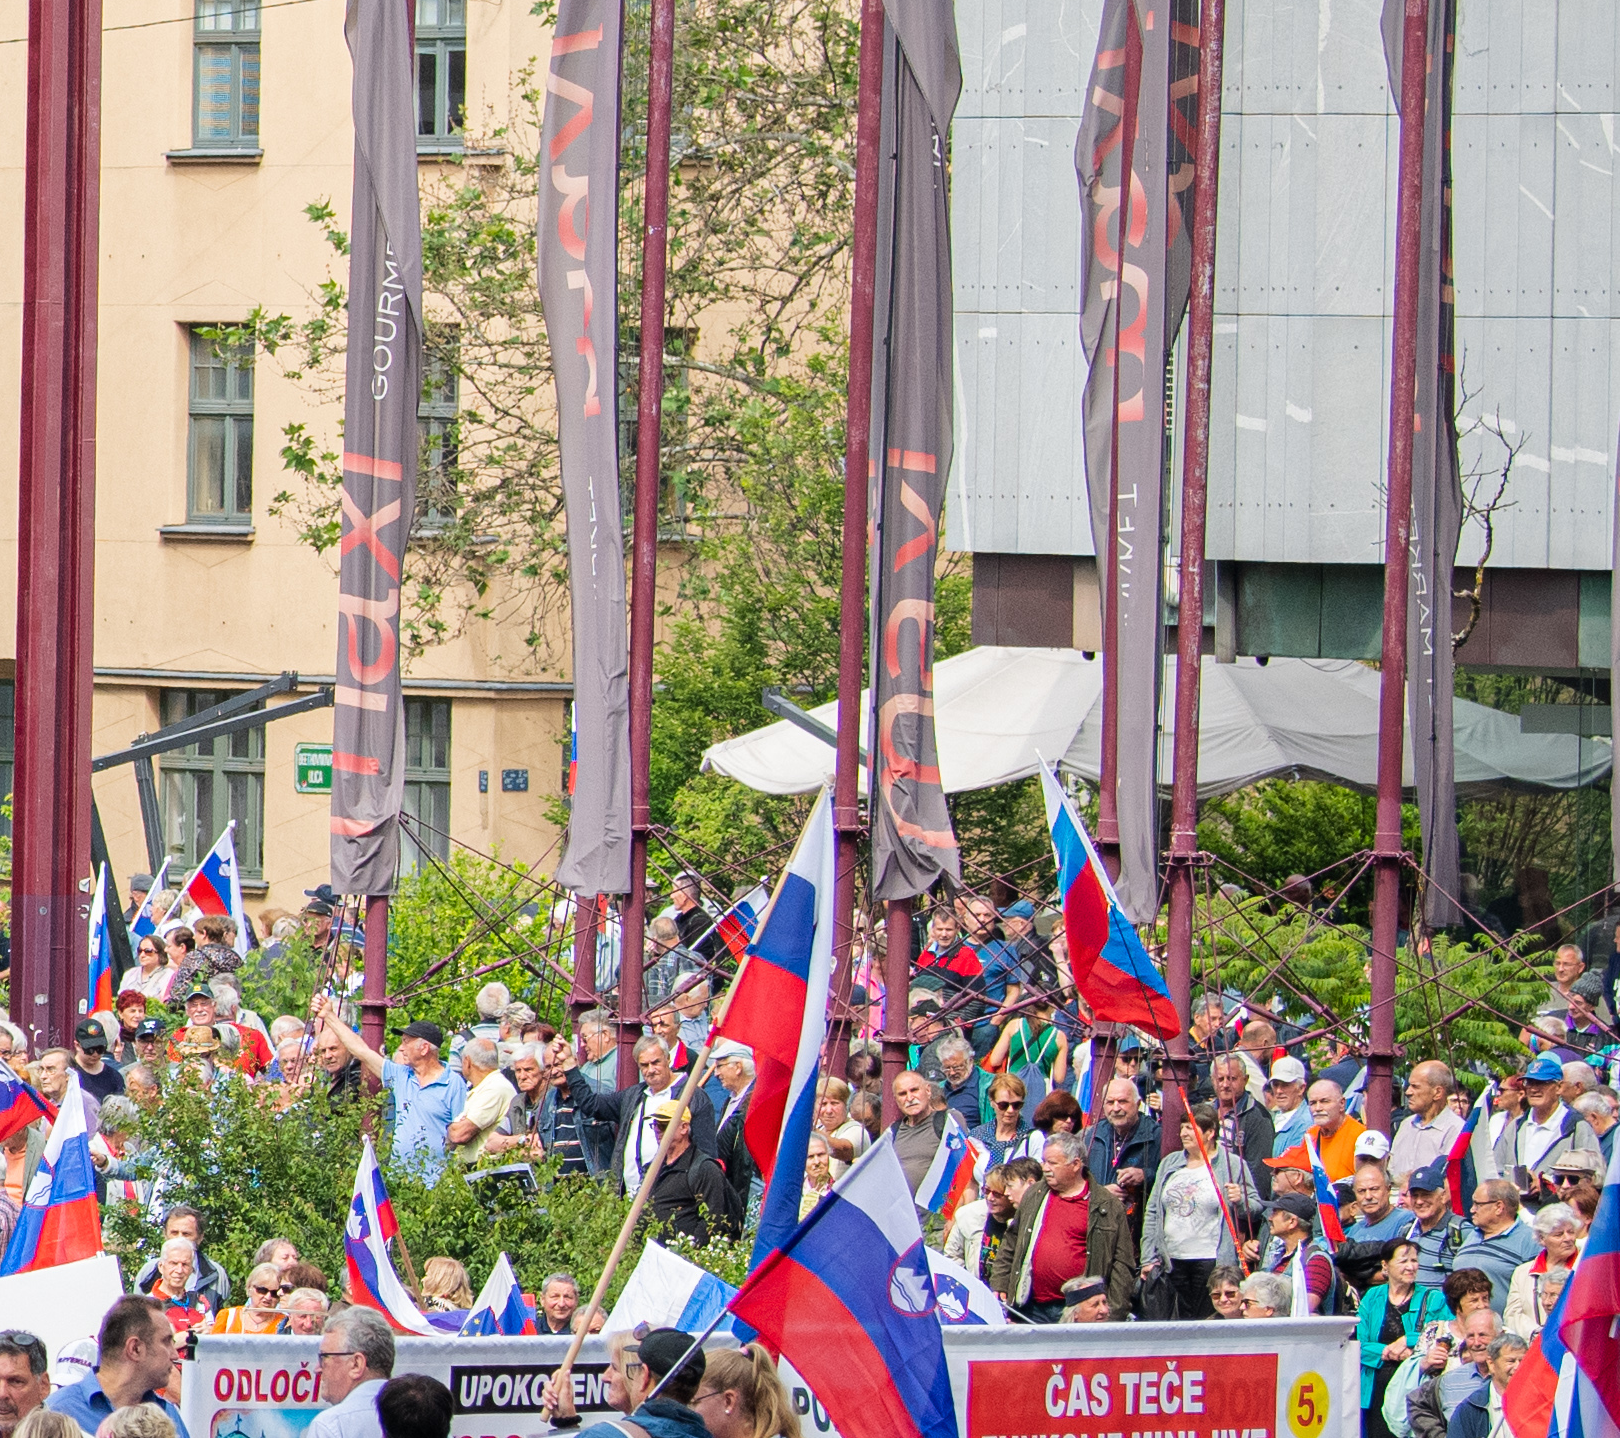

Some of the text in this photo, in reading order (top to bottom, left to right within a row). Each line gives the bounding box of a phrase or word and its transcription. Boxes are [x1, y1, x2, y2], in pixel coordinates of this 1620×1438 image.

[1045, 1361, 1205, 1418] ČAS TEČE
[1296, 1385, 1324, 1428] 5.
